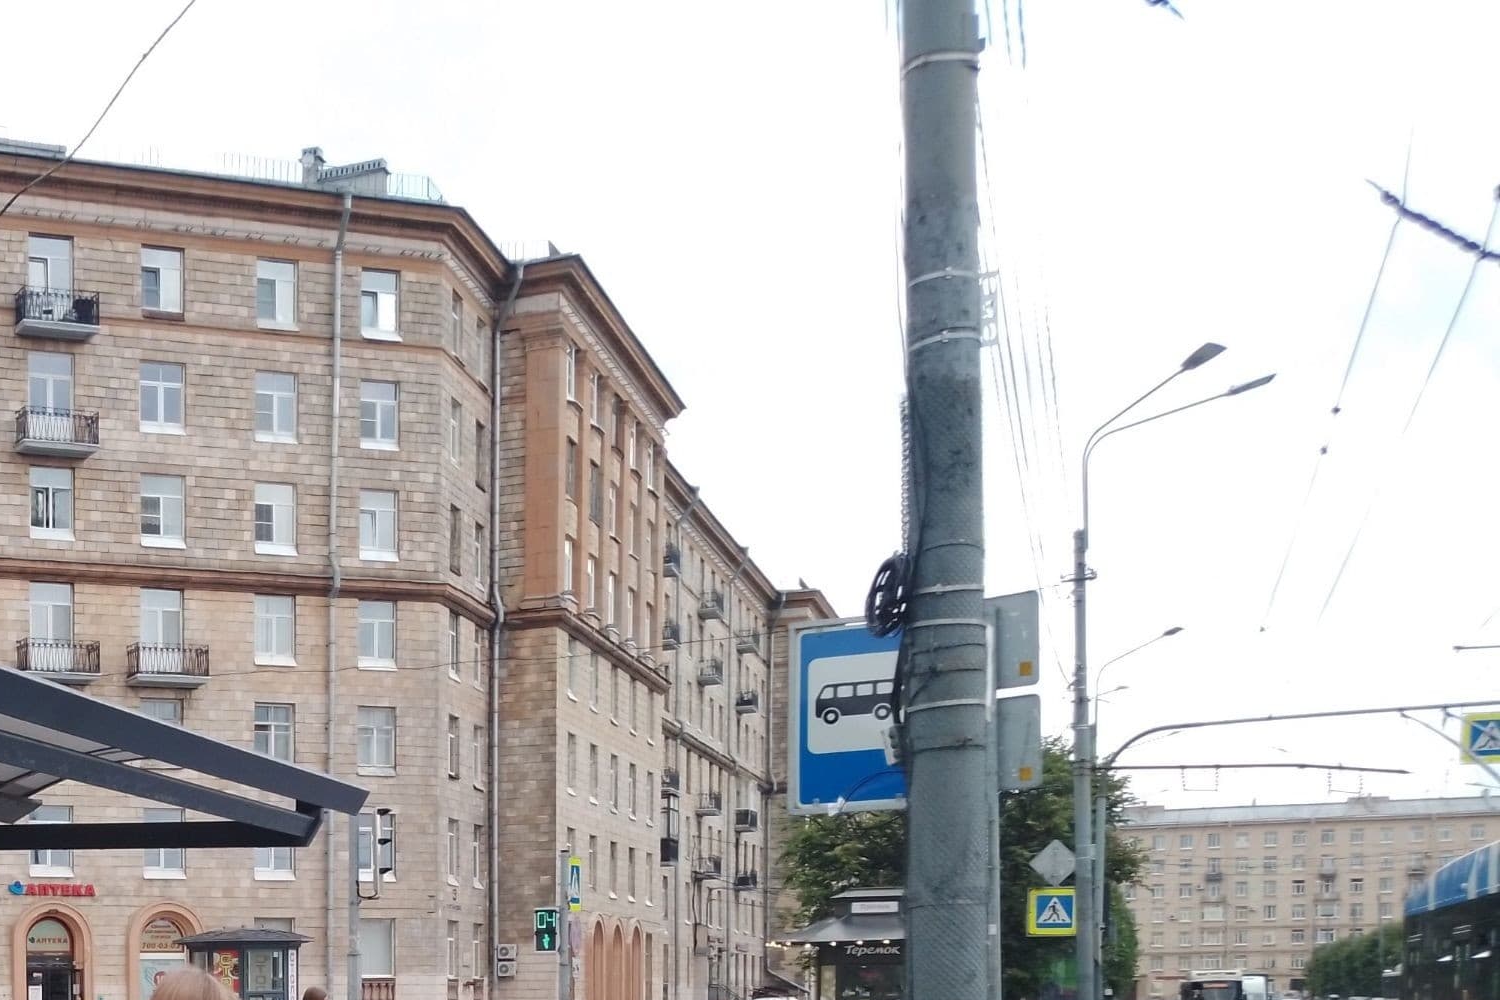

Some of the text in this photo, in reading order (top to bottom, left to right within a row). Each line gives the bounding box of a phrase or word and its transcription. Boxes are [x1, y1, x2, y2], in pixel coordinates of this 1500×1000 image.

[25, 884, 96, 896] АПТЕКА
[537, 911, 556, 929] 04
[844, 945, 900, 956] Теремок
